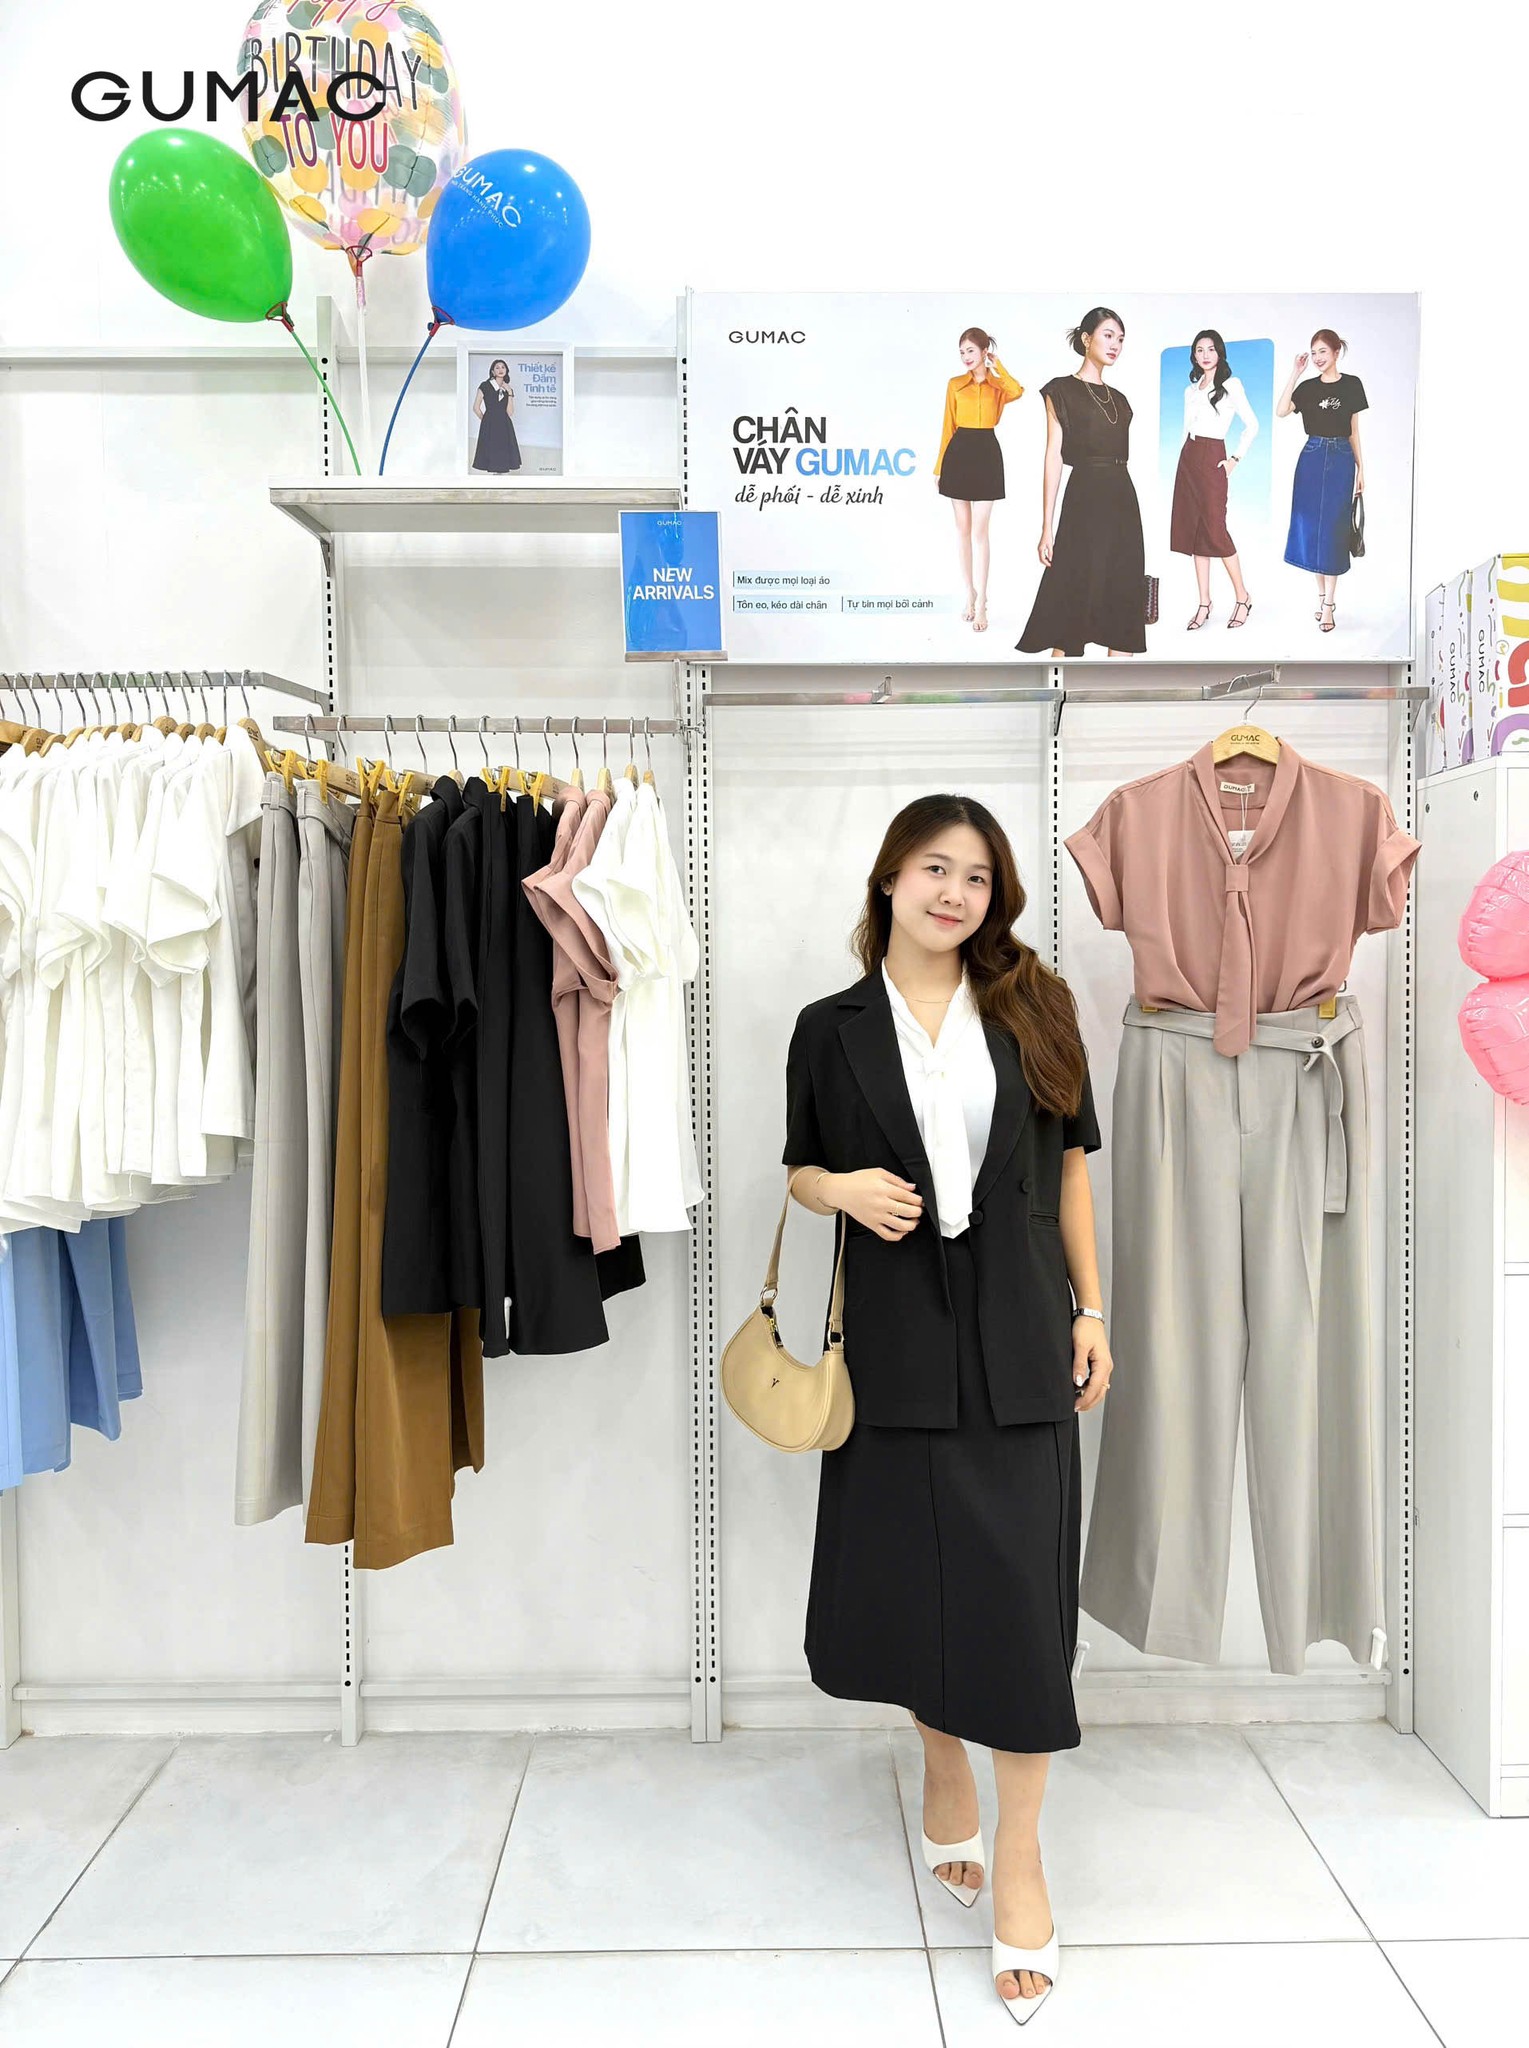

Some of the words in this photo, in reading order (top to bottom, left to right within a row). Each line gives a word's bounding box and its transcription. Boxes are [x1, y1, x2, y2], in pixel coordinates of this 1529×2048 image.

[250, 32, 421, 110] BIRTHDAY
[280, 112, 317, 168] TO
[330, 113, 387, 173] YOU
[452, 165, 521, 228] GUMAC
[729, 331, 806, 344] GUMAC
[518, 361, 543, 373] Thiết
[544, 362, 557, 373] kế
[524, 383, 545, 393] Tinh
[546, 384, 557, 393] tế
[733, 406, 827, 444] CHÂN
[733, 439, 791, 475] VÁY
[795, 447, 917, 477] GUMAC
[735, 484, 757, 503] dễ
[758, 484, 802, 512] phối
[820, 484, 844, 503] dễ
[846, 486, 884, 505] xinh
[653, 567, 693, 583] NEW
[737, 575, 753, 585] Mix
[755, 575, 780, 587] được
[782, 576, 799, 587] mọi
[800, 576, 817, 587] loại
[818, 576, 830, 586] áo
[633, 585, 715, 601] ARRIVALS
[737, 599, 754, 610] Tôn
[755, 602, 769, 611] eo,
[771, 600, 788, 610] kéo
[789, 600, 804, 610] dài
[805, 601, 828, 610] chân
[847, 599, 859, 611] Tự
[862, 600, 875, 609] tin
[877, 600, 893, 611] mọi
[911, 599, 934, 609] cảnh
[1478, 628, 1486, 694] GUMAC
[1448, 641, 1457, 704] GUMAC
[1230, 734, 1261, 742] GUMAC
